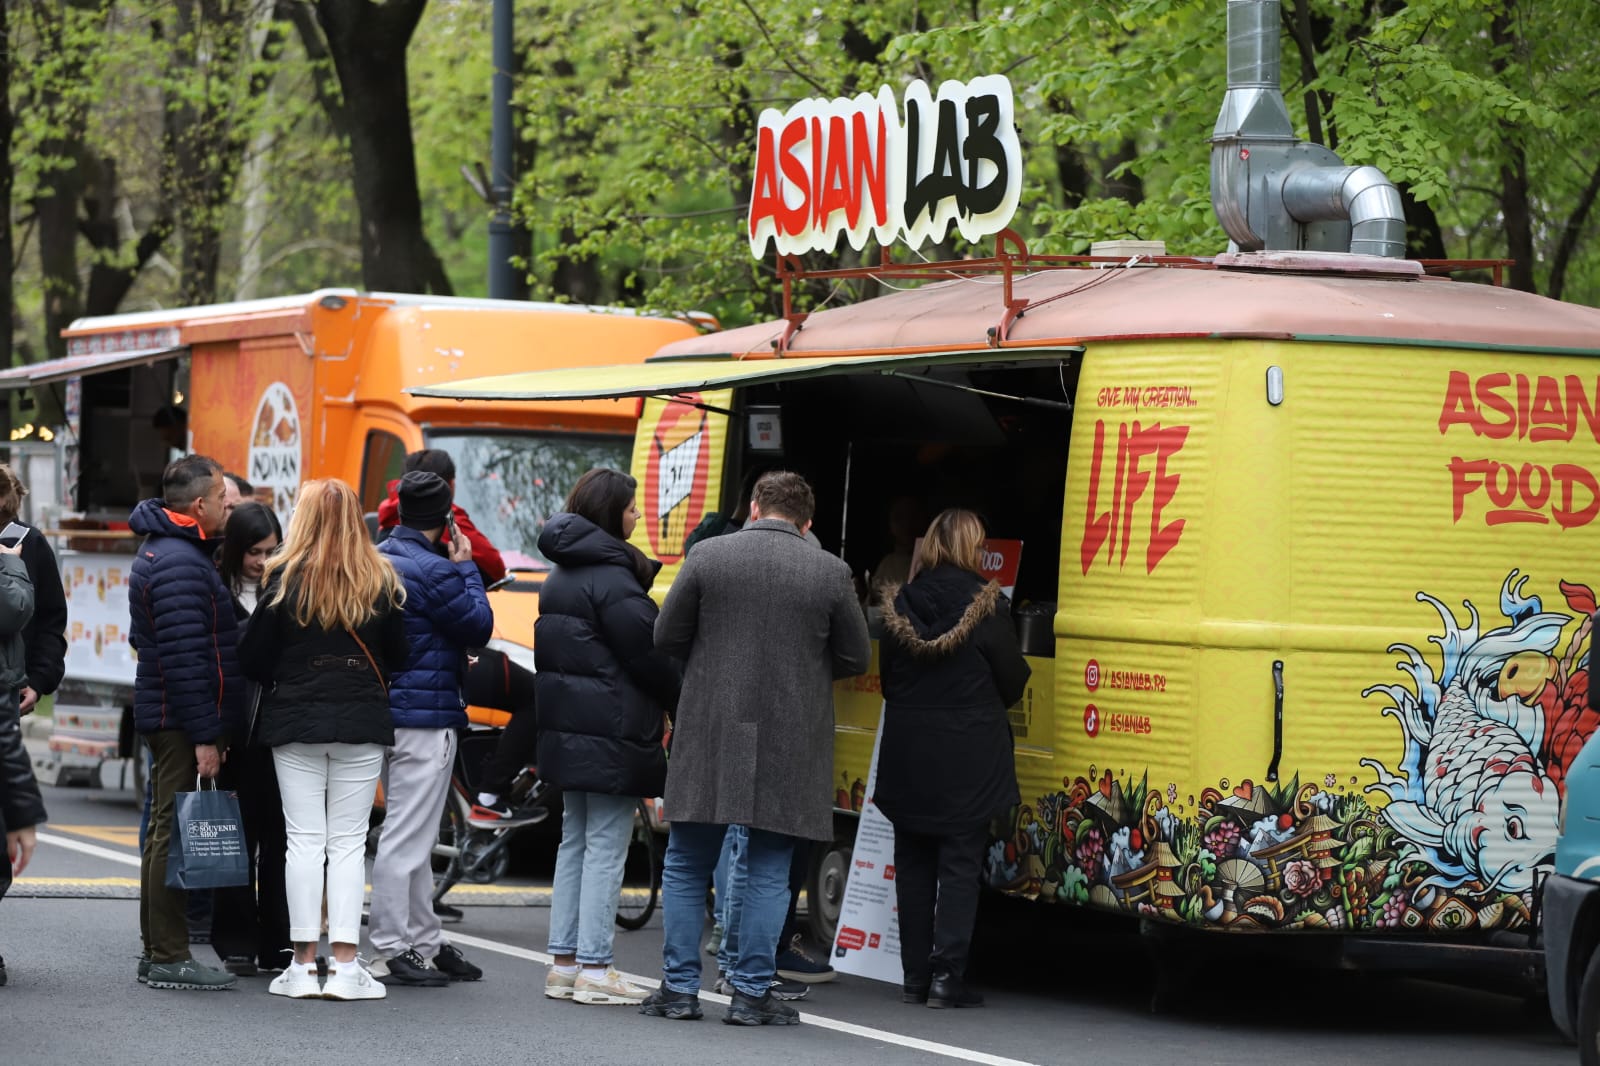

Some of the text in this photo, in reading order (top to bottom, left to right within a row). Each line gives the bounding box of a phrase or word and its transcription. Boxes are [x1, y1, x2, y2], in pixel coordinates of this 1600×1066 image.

[750, 94, 1008, 241] ASIAN LAB
[1097, 387, 1121, 407] GIVE
[1123, 387, 1141, 414] MY
[1438, 370, 1600, 445] ASIAN
[1080, 418, 1190, 577] LIFE
[1445, 456, 1600, 532] FOOD
[980, 550, 1004, 571] OOD
[1110, 671, 1166, 692] ASIANLAB.RO
[1110, 713, 1152, 735] ASIANLAB
[200, 824, 238, 833] SOUVENIR
